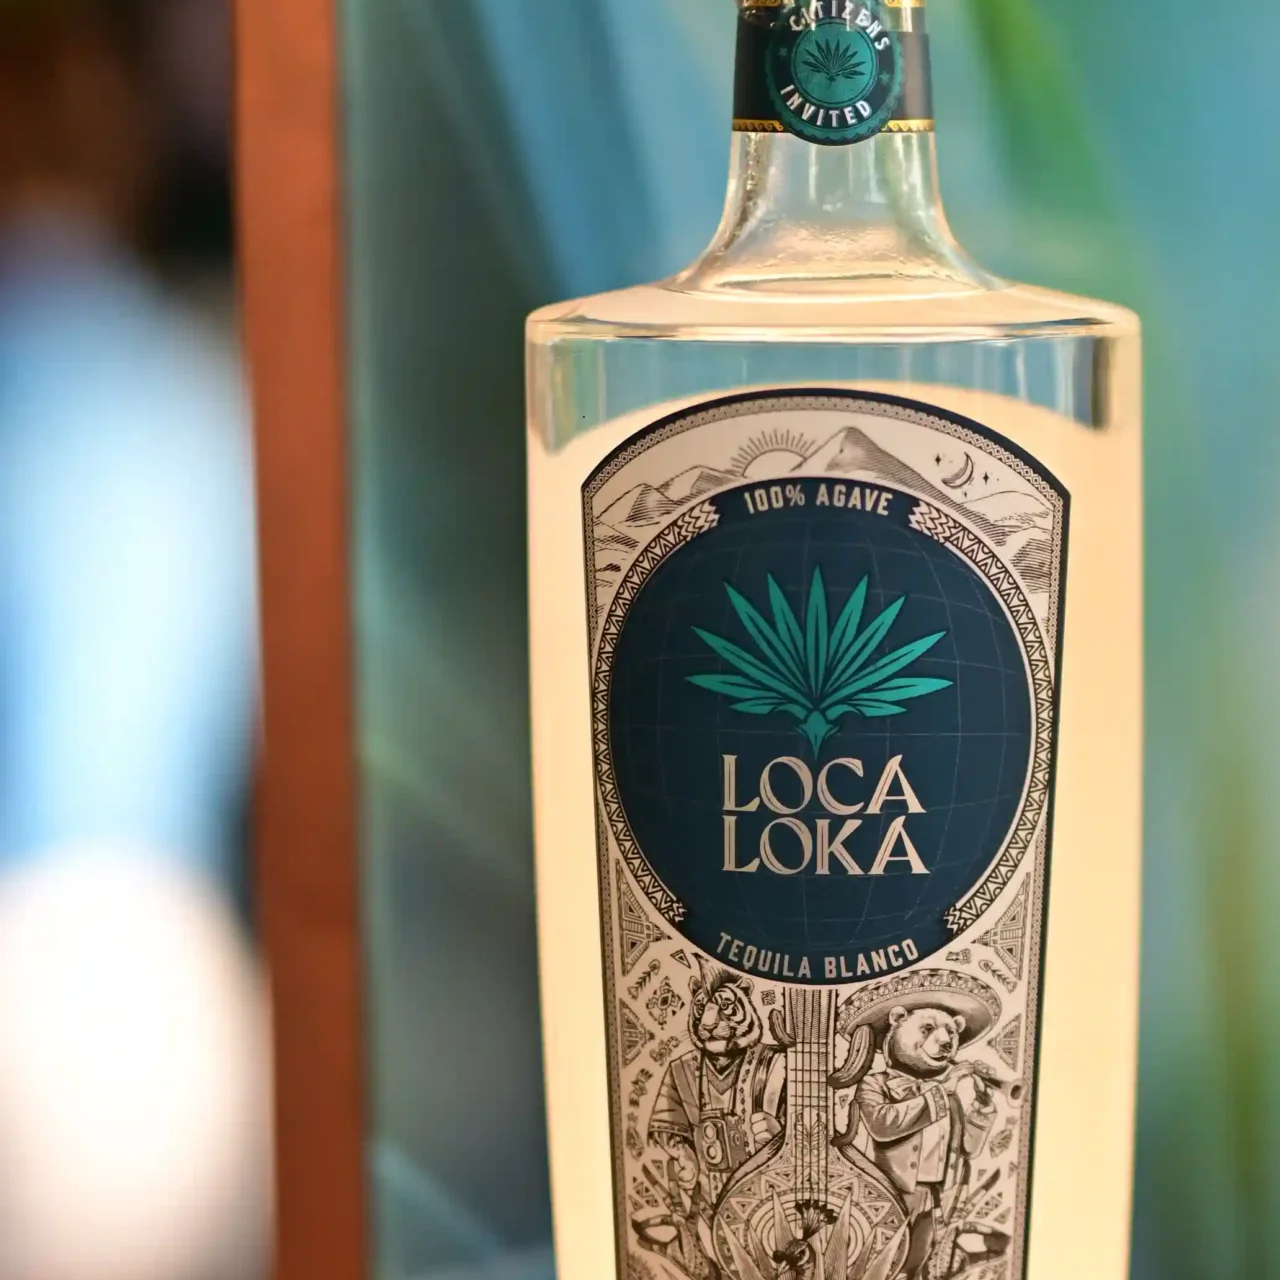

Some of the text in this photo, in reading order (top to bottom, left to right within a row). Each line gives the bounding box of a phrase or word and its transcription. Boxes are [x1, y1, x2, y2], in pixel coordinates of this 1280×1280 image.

[788, 0, 891, 53] CITIZENS
[779, 83, 873, 128] INVITED
[743, 483, 893, 516] 100% AGAVE
[722, 754, 928, 815] LOCA
[722, 815, 931, 875] LOKA
[715, 931, 919, 979] TEQUILA BLANCO
